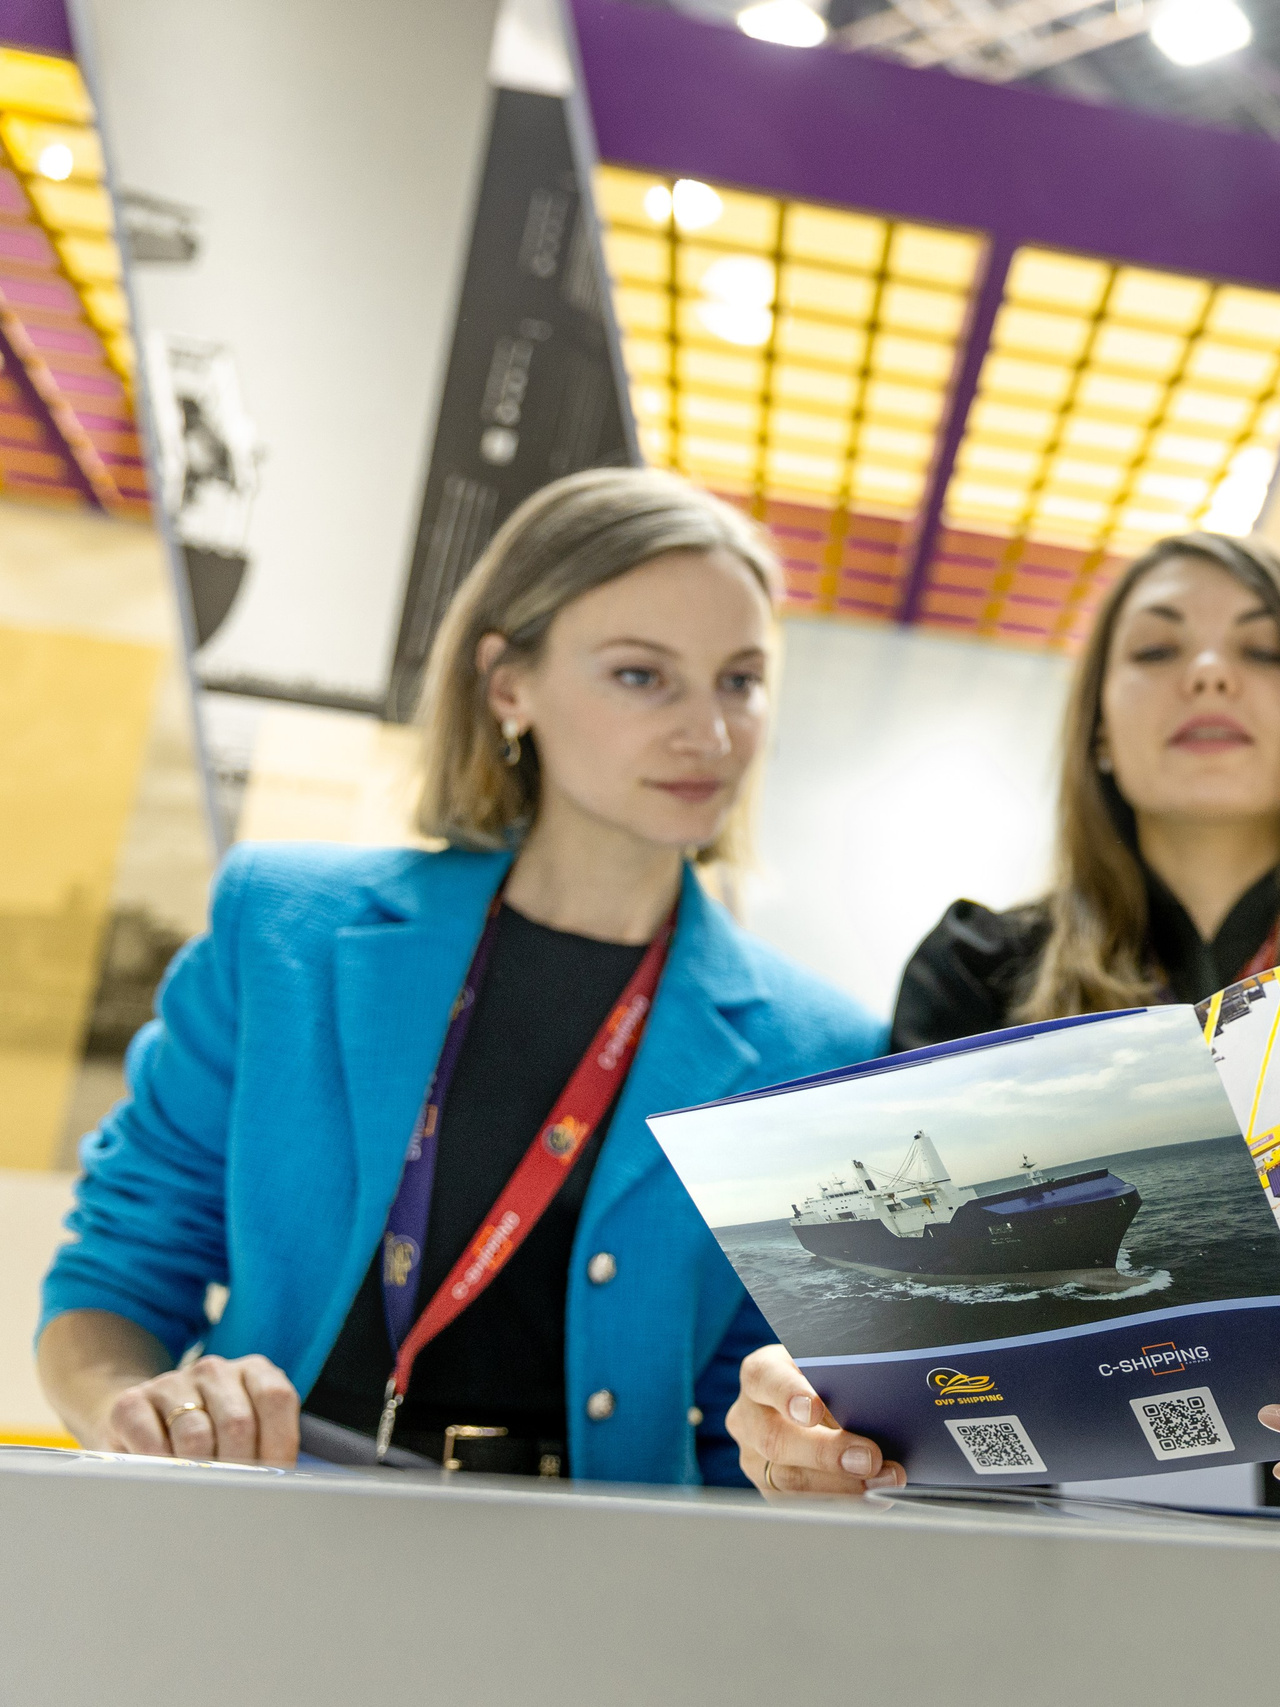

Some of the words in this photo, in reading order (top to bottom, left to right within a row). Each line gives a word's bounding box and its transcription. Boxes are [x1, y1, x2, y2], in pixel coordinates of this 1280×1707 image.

[1098, 1345, 1210, 1377] C-SHIPPING
[934, 1398, 955, 1406] OVP
[957, 1393, 1004, 1405] SHIPPING
